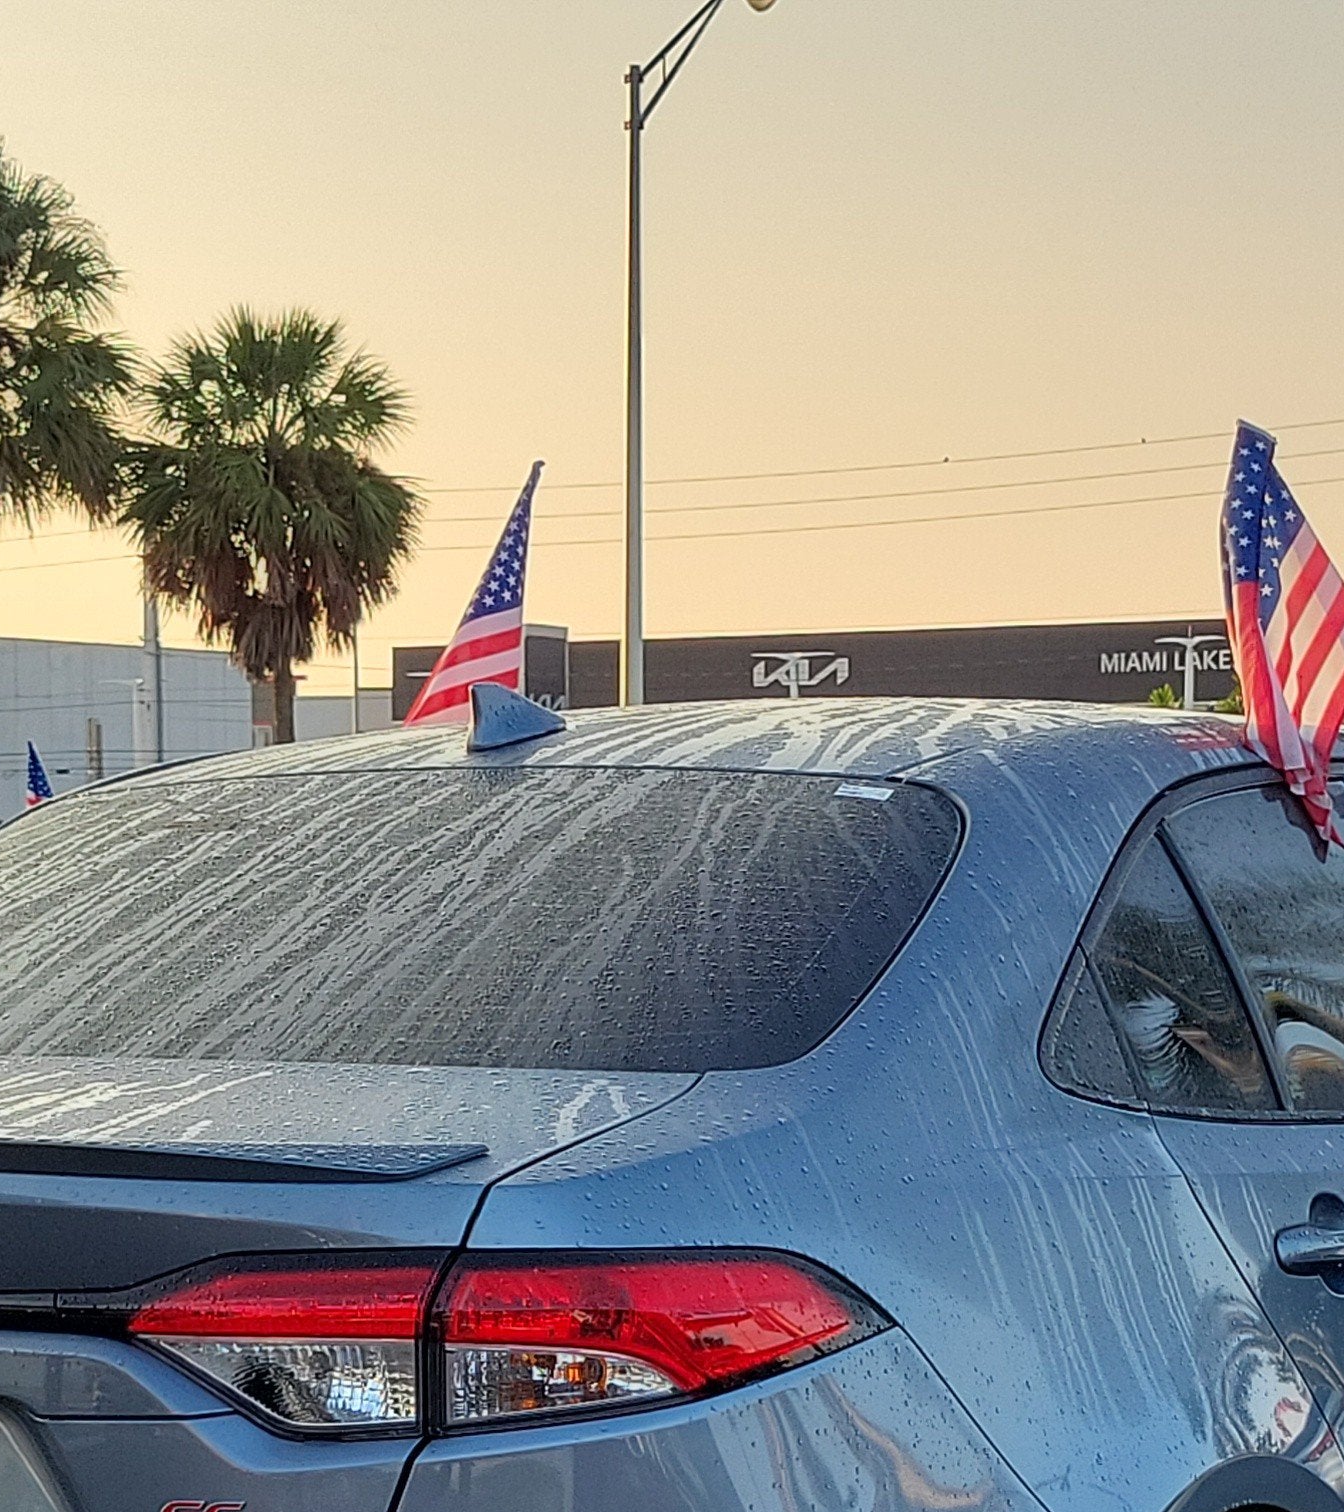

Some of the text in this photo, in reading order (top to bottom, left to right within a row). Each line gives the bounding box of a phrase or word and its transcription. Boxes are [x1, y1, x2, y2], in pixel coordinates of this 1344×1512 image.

[752, 657, 850, 687] KIA
[1100, 649, 1232, 674] MIAMI LAKE
